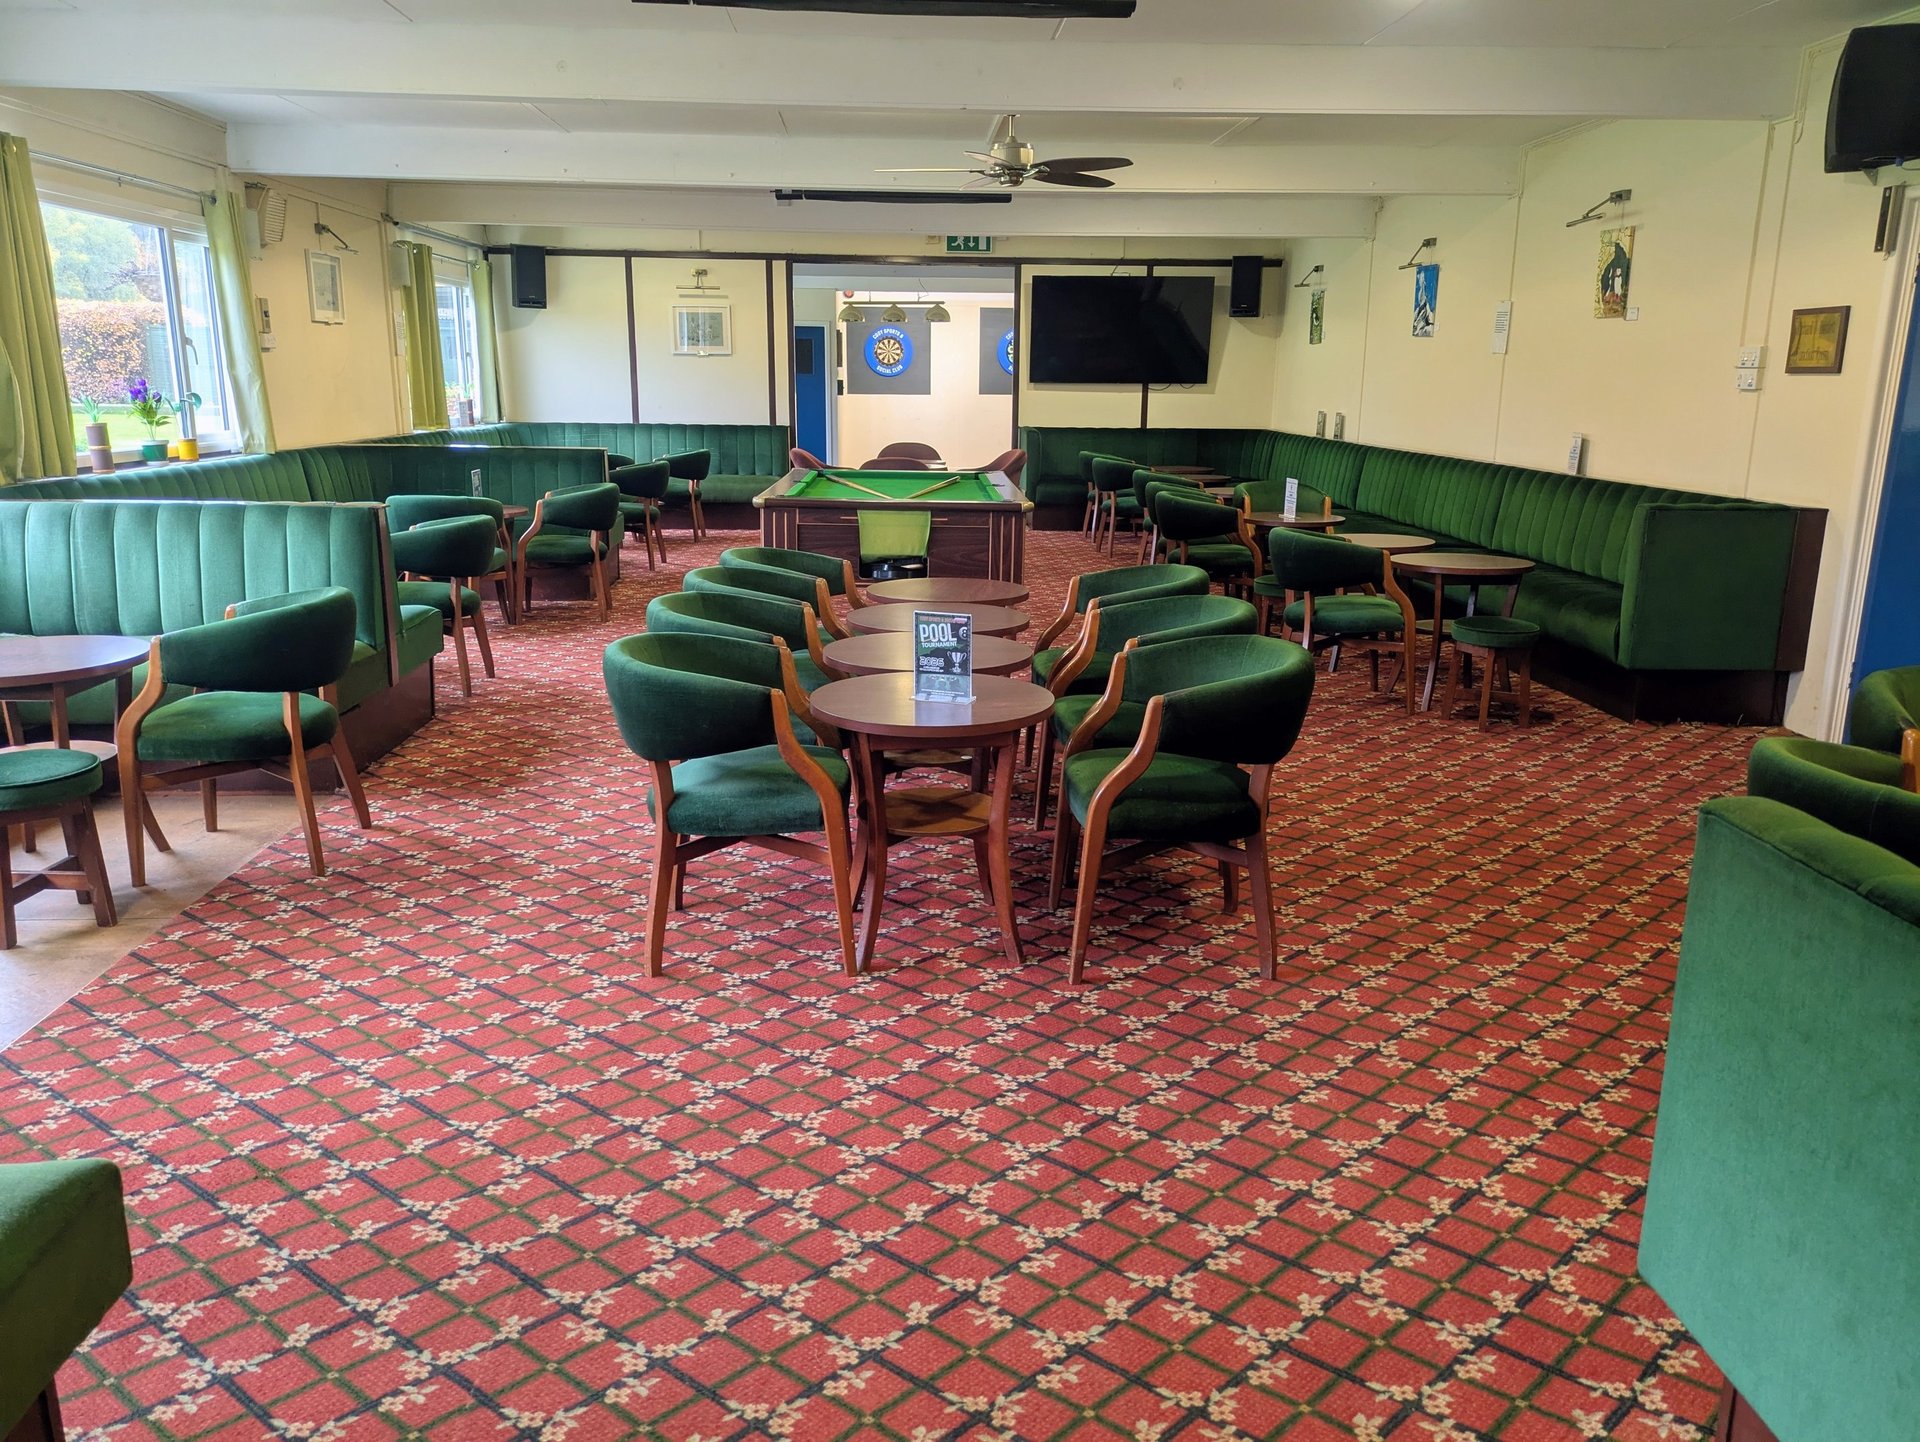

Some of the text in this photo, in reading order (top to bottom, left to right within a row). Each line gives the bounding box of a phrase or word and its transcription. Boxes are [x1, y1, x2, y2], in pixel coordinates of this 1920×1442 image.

[892, 365, 903, 373] CLUB
[919, 623, 957, 642] POOL
[920, 656, 944, 667] 2026
